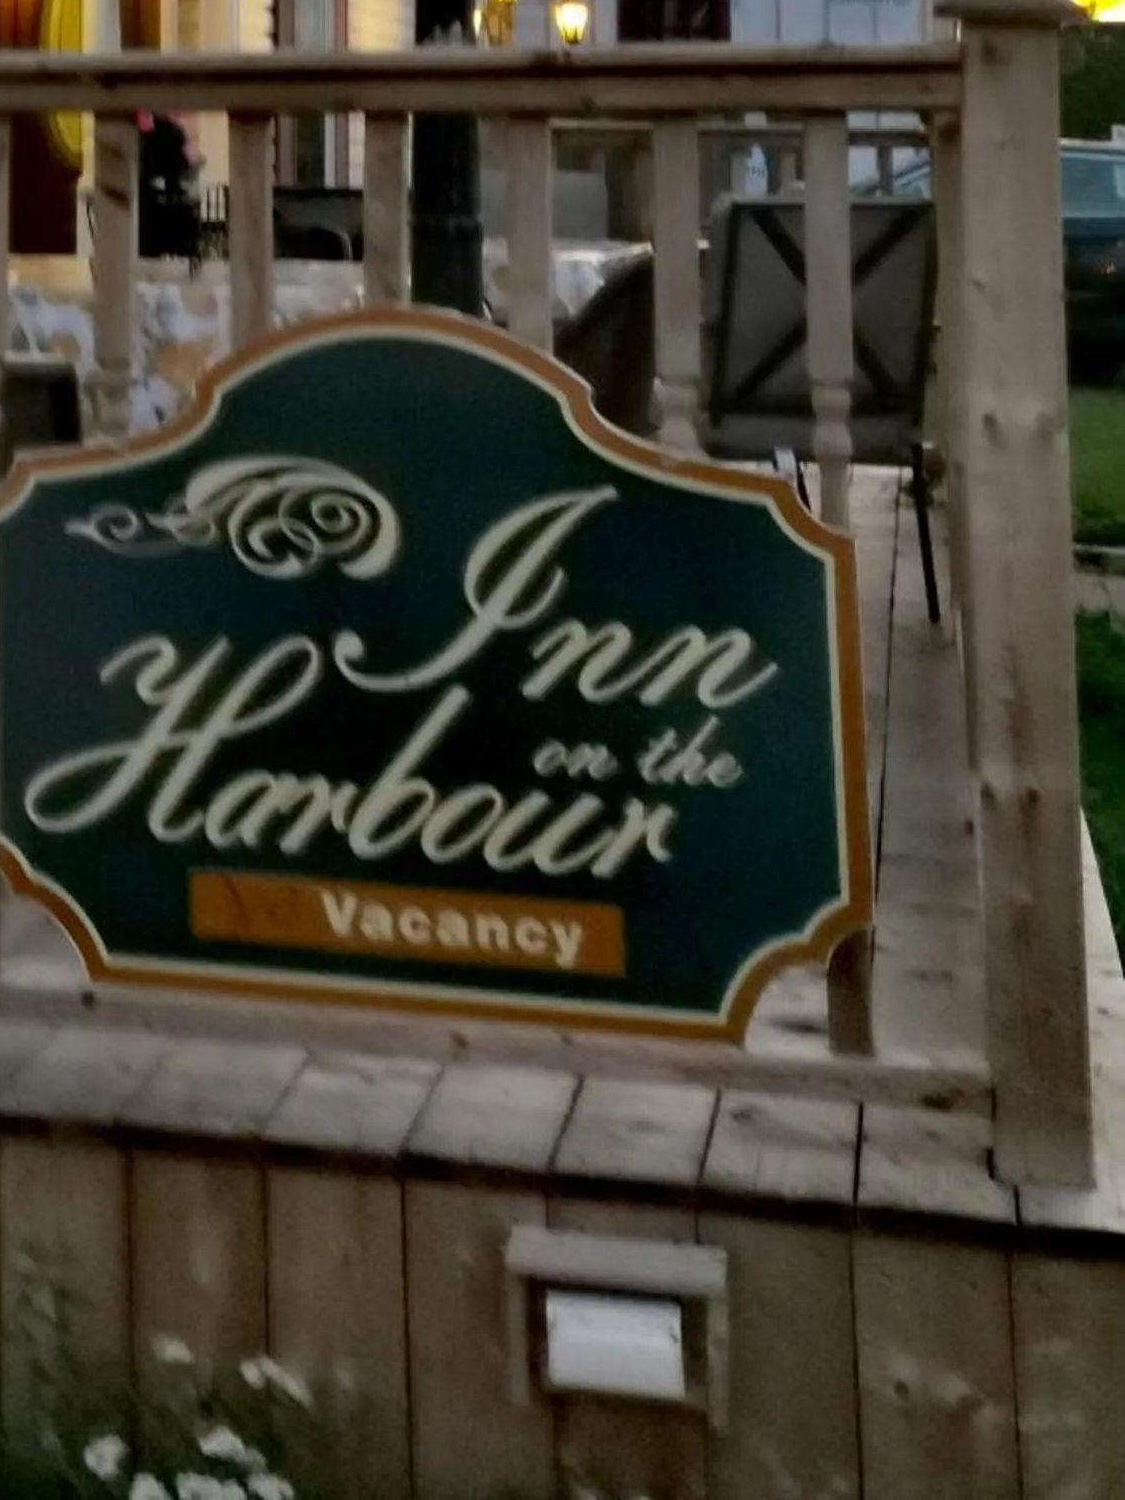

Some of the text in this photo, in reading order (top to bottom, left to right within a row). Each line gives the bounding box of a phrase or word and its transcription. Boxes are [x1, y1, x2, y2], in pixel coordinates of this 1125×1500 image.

[333, 484, 778, 708] Inn
[23, 633, 677, 879] Harbour
[533, 714, 746, 788] on the
[320, 889, 585, 968] Vacancy
